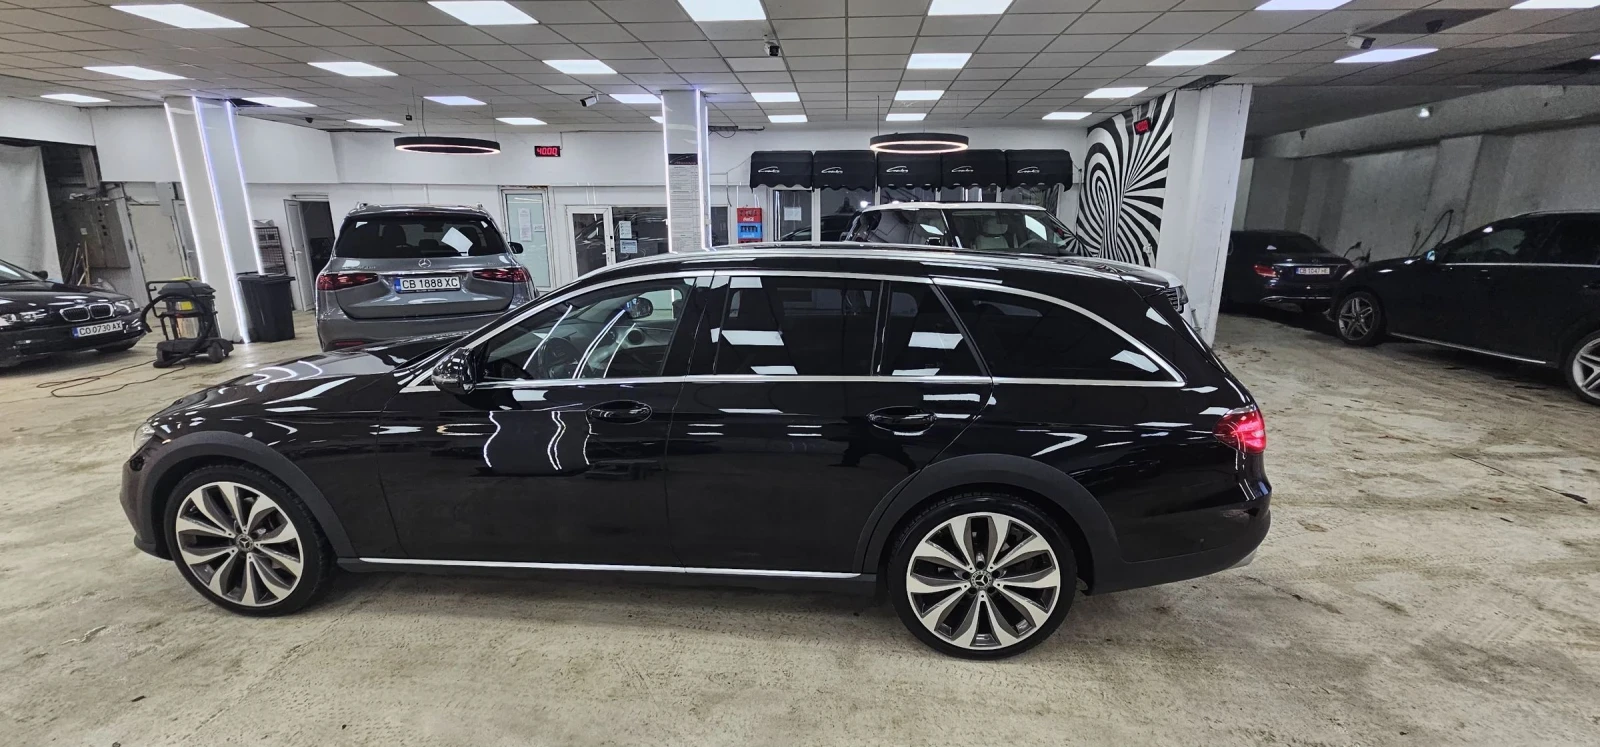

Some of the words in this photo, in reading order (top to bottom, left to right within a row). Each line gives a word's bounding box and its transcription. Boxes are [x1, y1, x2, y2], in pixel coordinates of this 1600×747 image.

[402, 280, 416, 289] CB
[419, 279, 443, 288] 1888
[444, 278, 458, 287] XC
[79, 328, 91, 336] CO
[92, 324, 111, 333] 0730
[112, 322, 121, 330] AX
